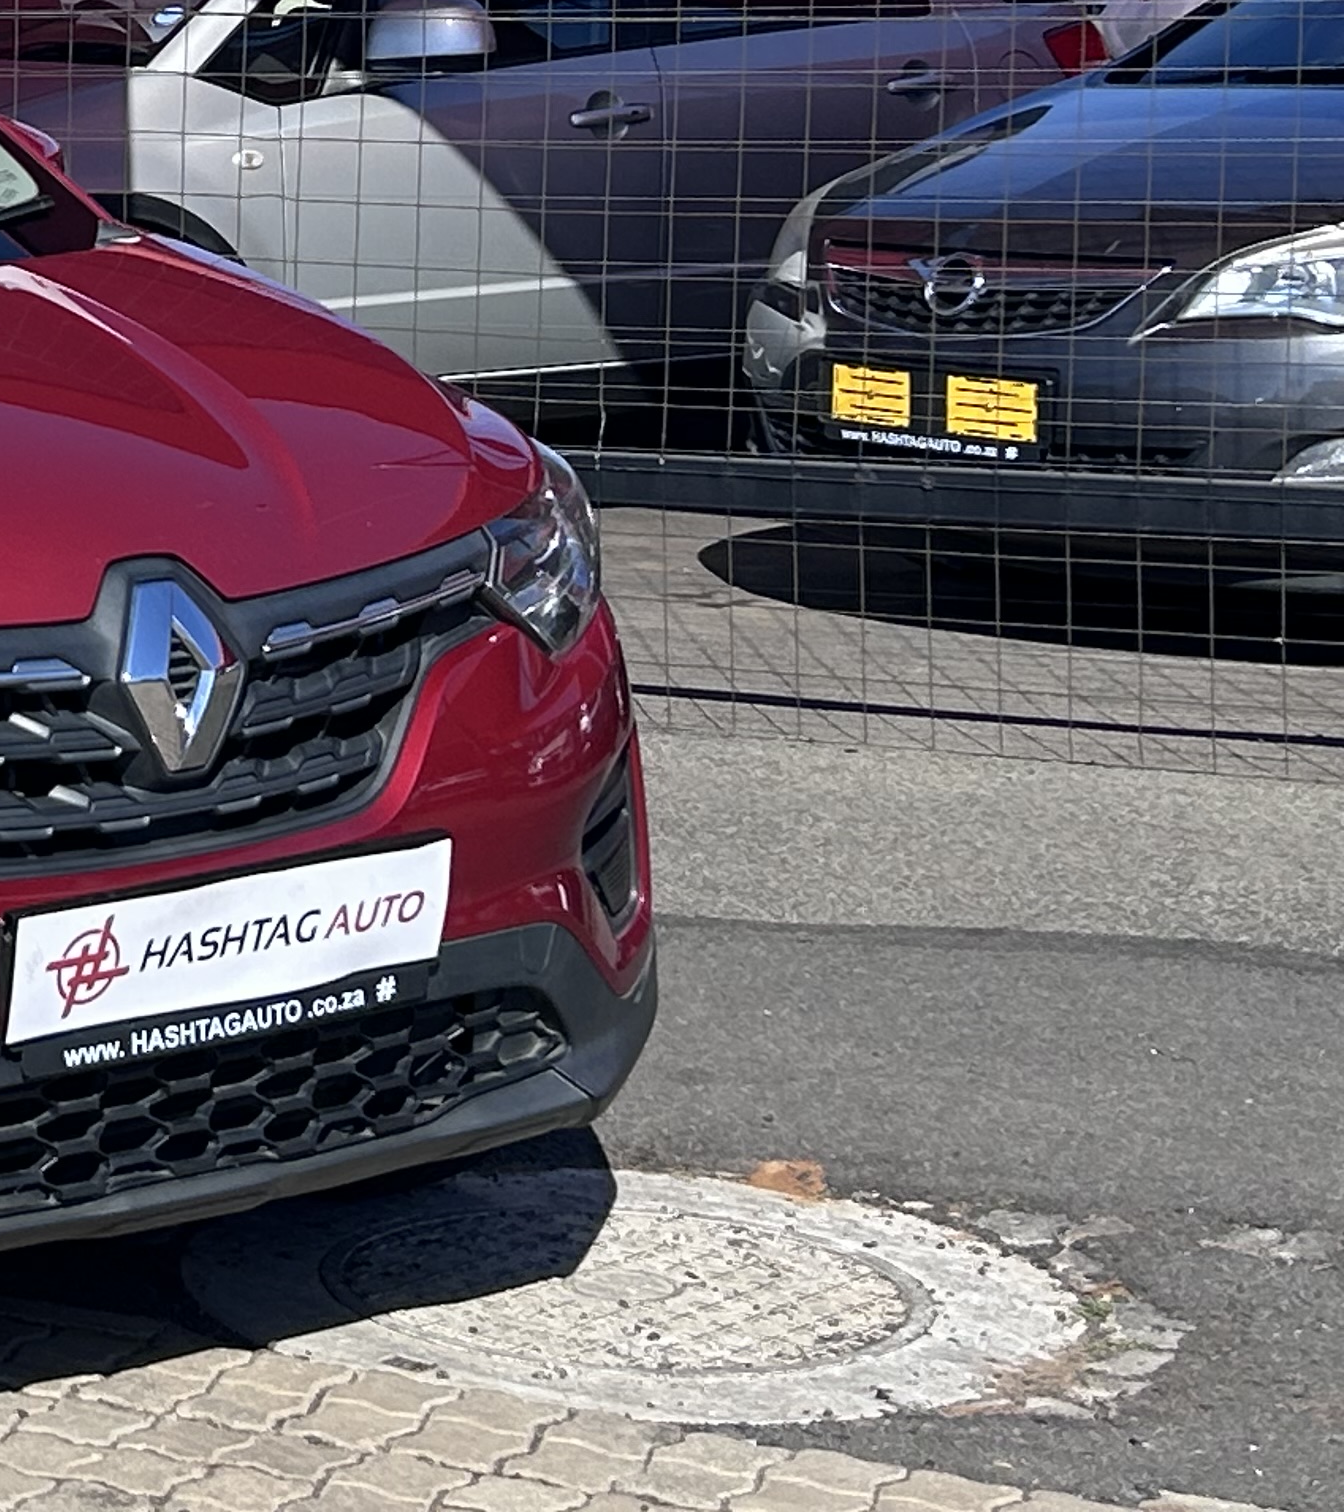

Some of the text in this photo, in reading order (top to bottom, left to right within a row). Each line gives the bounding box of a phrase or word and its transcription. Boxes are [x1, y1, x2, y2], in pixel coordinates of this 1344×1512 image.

[139, 890, 425, 972] HASHTAG AUTO
[63, 1040, 126, 1068] www.
[130, 999, 303, 1056] HASHTAGAUTO
[307, 989, 366, 1019] .co.za
